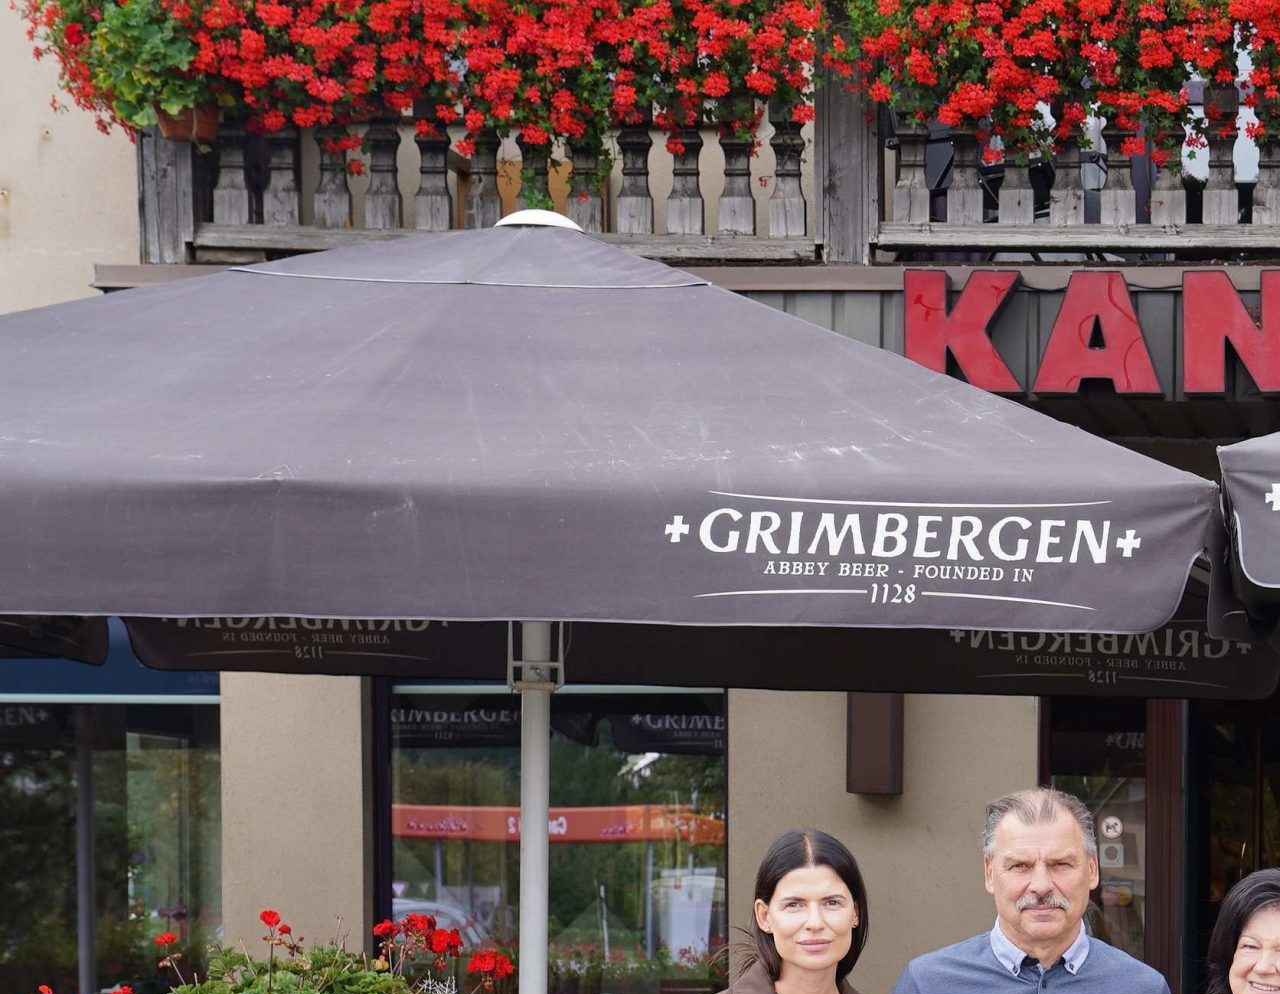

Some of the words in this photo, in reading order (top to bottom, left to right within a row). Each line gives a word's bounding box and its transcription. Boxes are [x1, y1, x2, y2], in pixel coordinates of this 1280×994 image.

[699, 508, 1111, 564] GRIMBERGEN
[763, 560, 829, 576] ABBEY
[838, 562, 889, 578] BEER
[913, 564, 1004, 582] FOUNDED
[1013, 568, 1034, 582] IN
[870, 583, 916, 604] 1128
